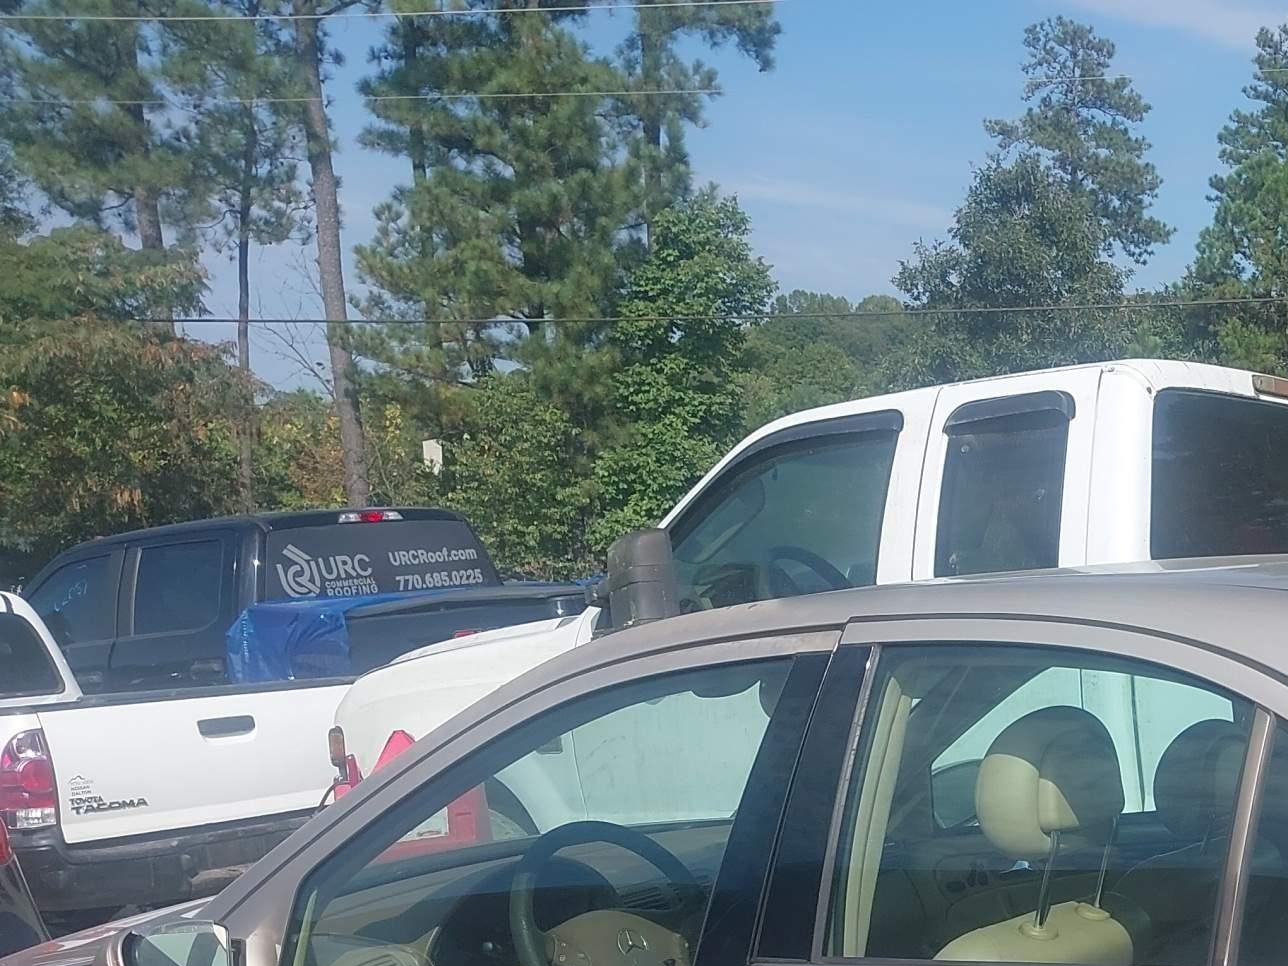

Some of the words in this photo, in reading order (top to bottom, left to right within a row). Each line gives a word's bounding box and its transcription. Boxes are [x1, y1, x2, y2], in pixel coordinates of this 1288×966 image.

[388, 547, 477, 566] URCRoof.com
[317, 553, 373, 580] URC
[324, 577, 376, 588] COMMERCIAL
[395, 568, 483, 591] 770.685.0225
[326, 584, 379, 597] ROOFING
[69, 795, 104, 806] TOYOTA
[71, 798, 149, 815] TACOMA
